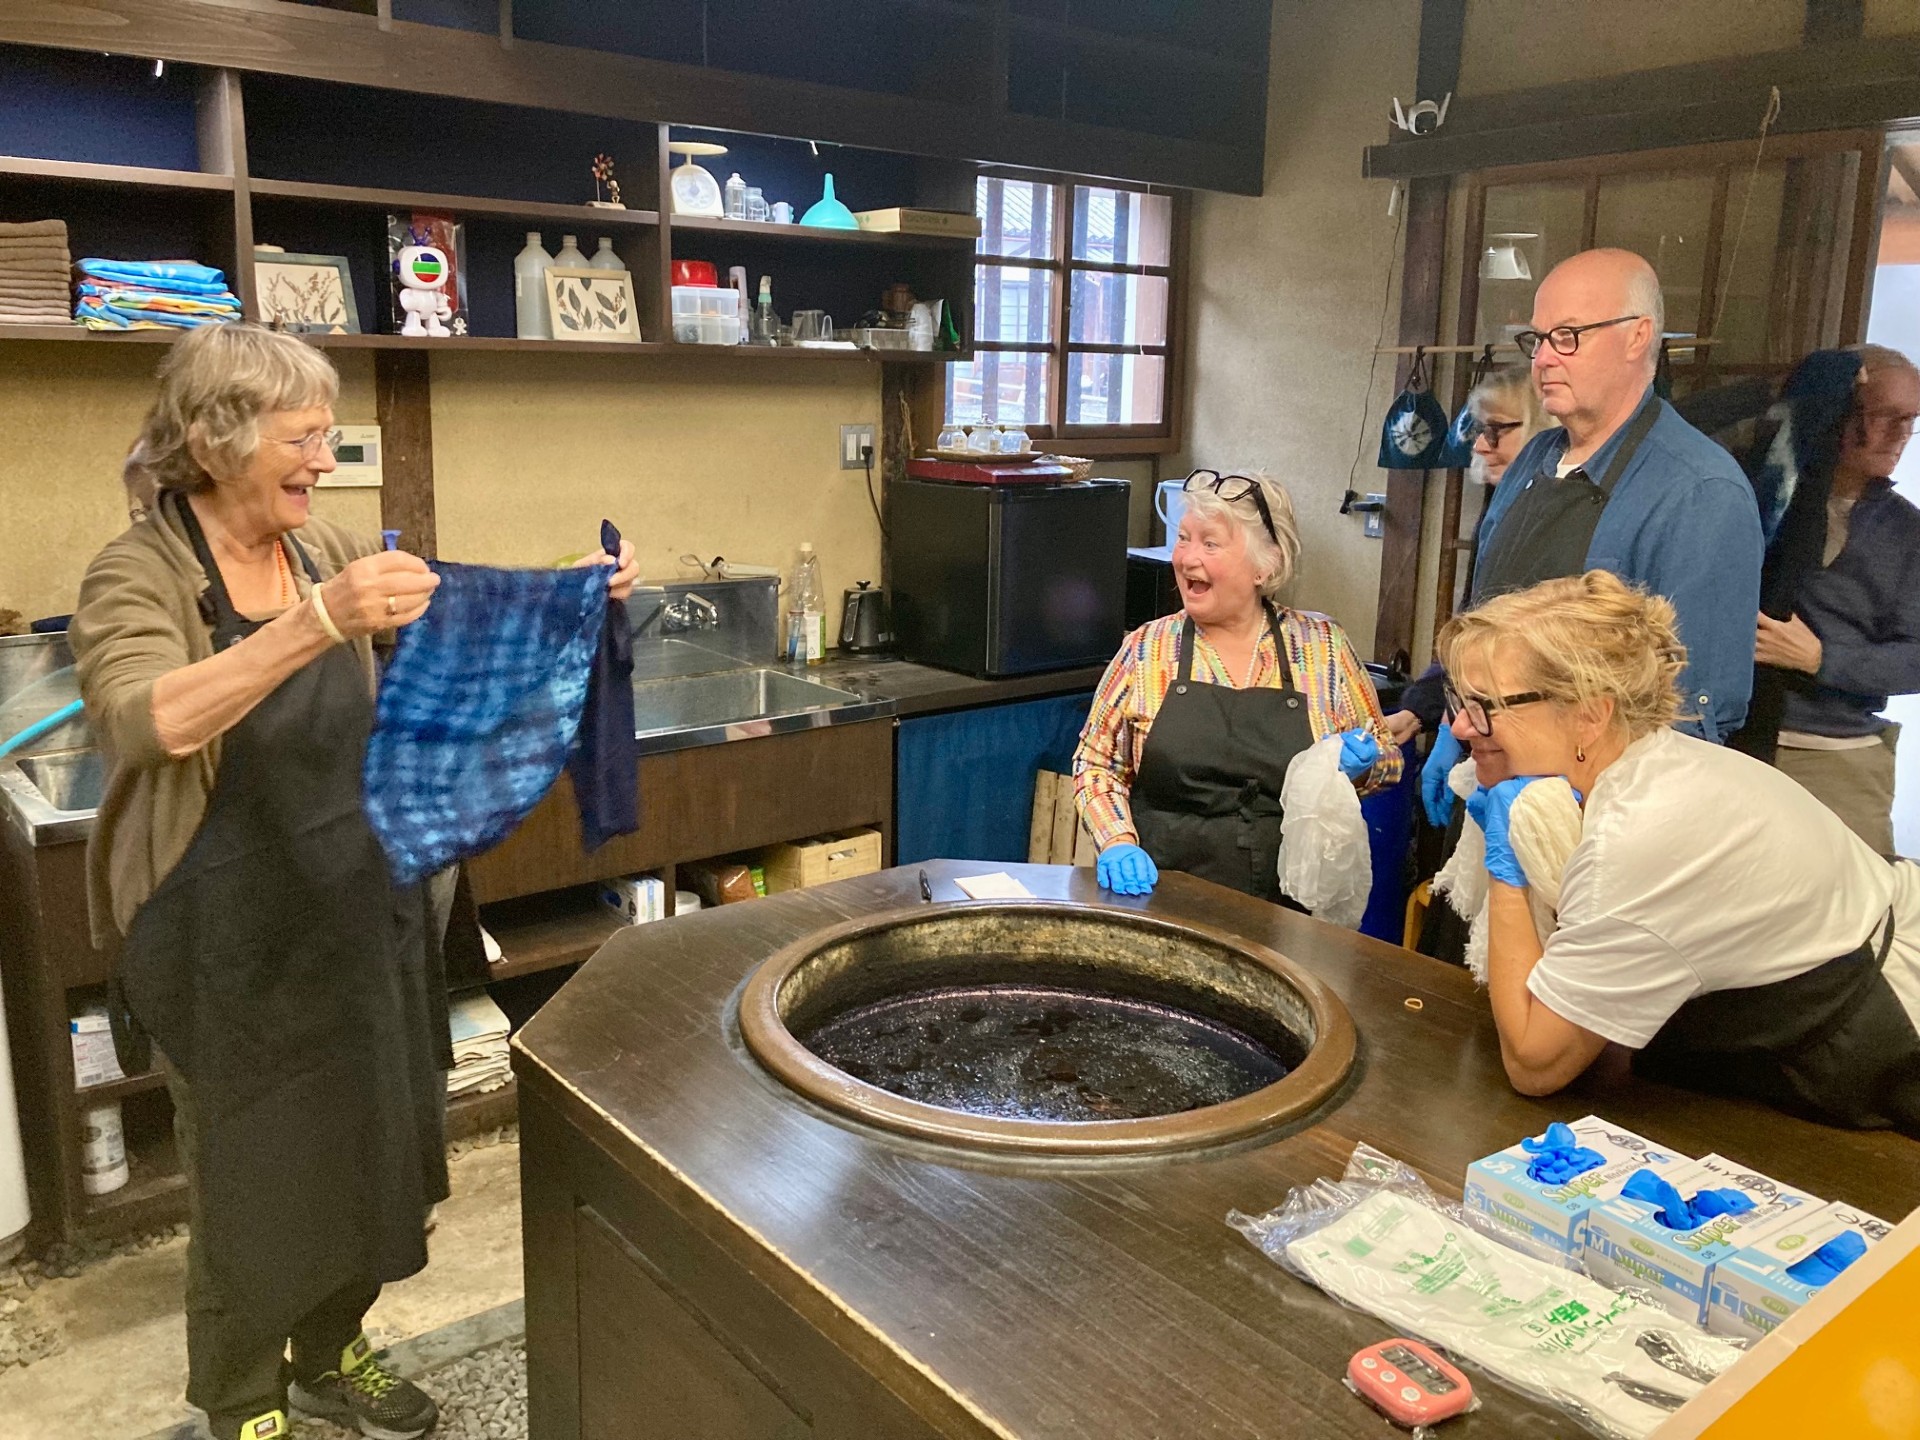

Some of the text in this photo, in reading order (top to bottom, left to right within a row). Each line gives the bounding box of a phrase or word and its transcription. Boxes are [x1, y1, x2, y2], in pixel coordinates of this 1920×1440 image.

[1541, 1172, 1608, 1204] Super
[1600, 1198, 1649, 1223] M
[1591, 1233, 1605, 1253] M
[1672, 1216, 1742, 1251] Super
[1615, 1245, 1665, 1285] Super
[1730, 1256, 1777, 1276] L
[1720, 1288, 1733, 1312] L
